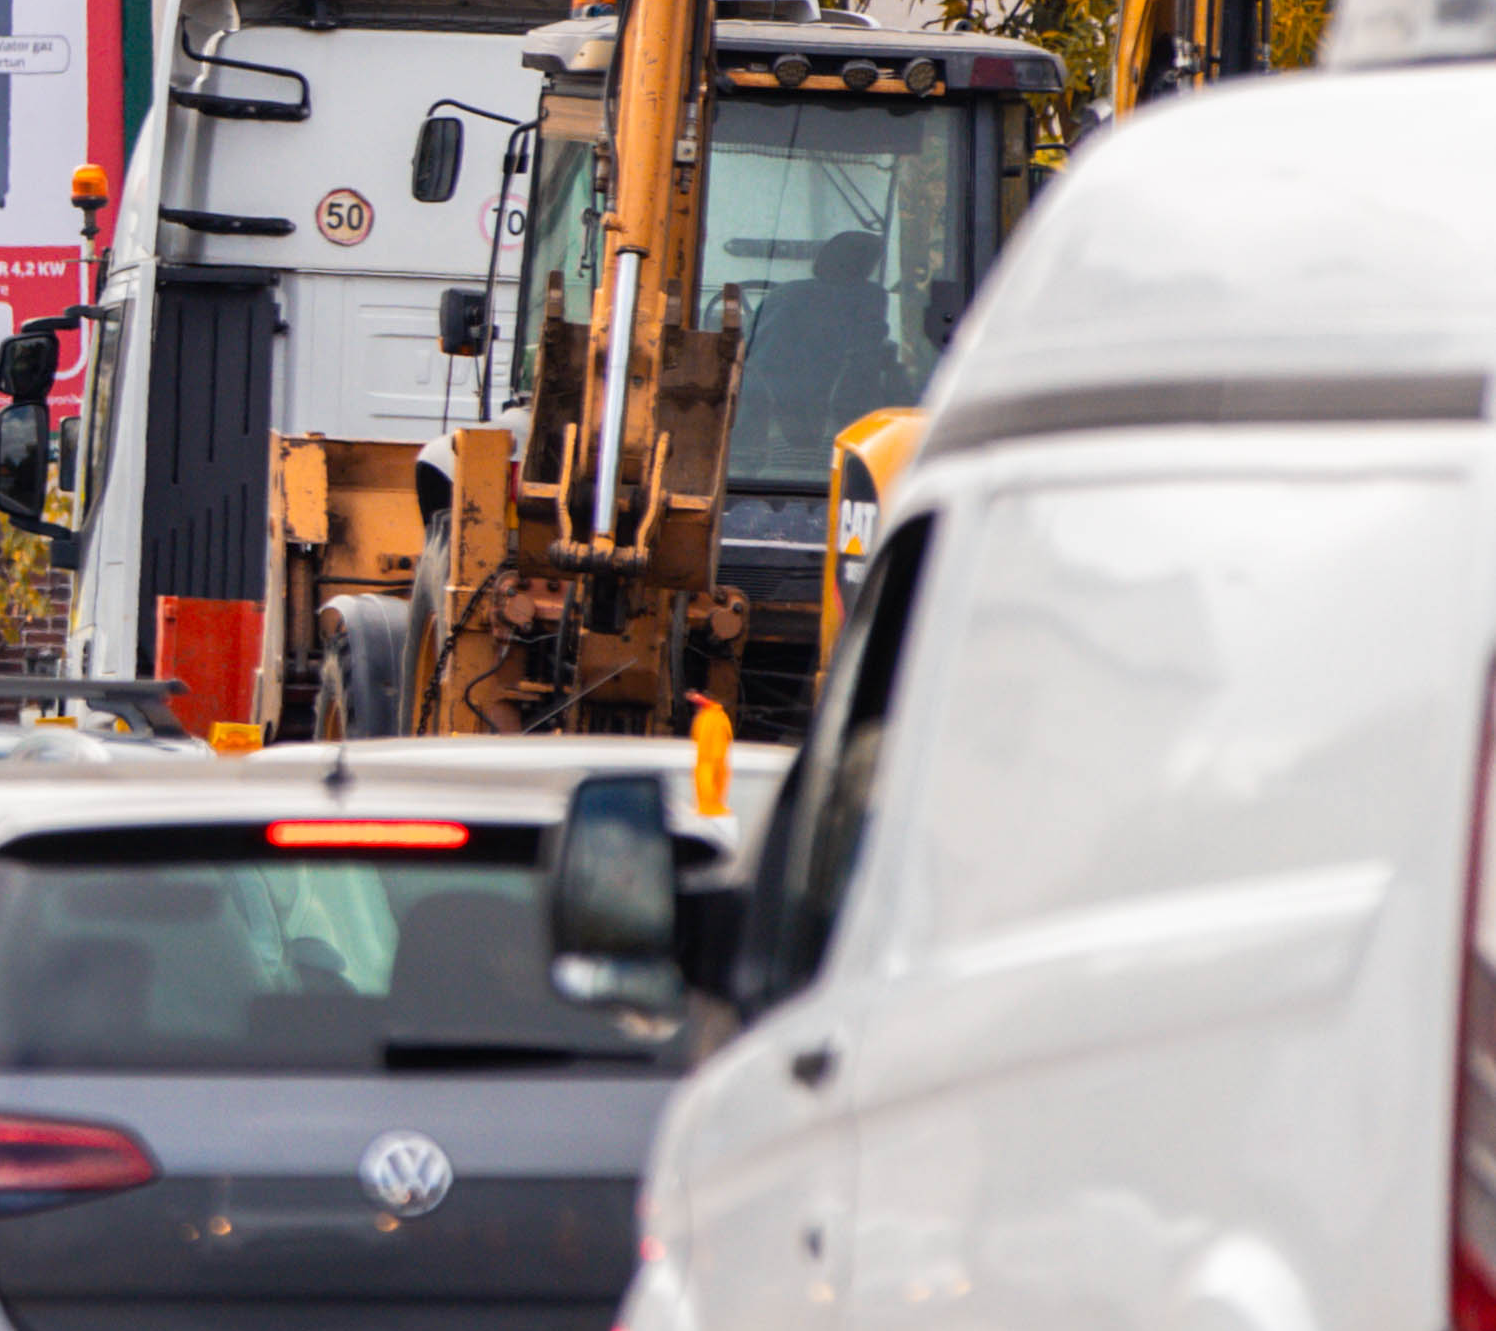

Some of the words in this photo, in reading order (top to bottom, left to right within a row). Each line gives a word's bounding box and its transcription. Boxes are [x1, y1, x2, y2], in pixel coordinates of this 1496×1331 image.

[32, 41, 53, 53] gaz
[326, 202, 364, 231] 50
[11, 261, 35, 278] 4,2
[37, 261, 67, 277] KW
